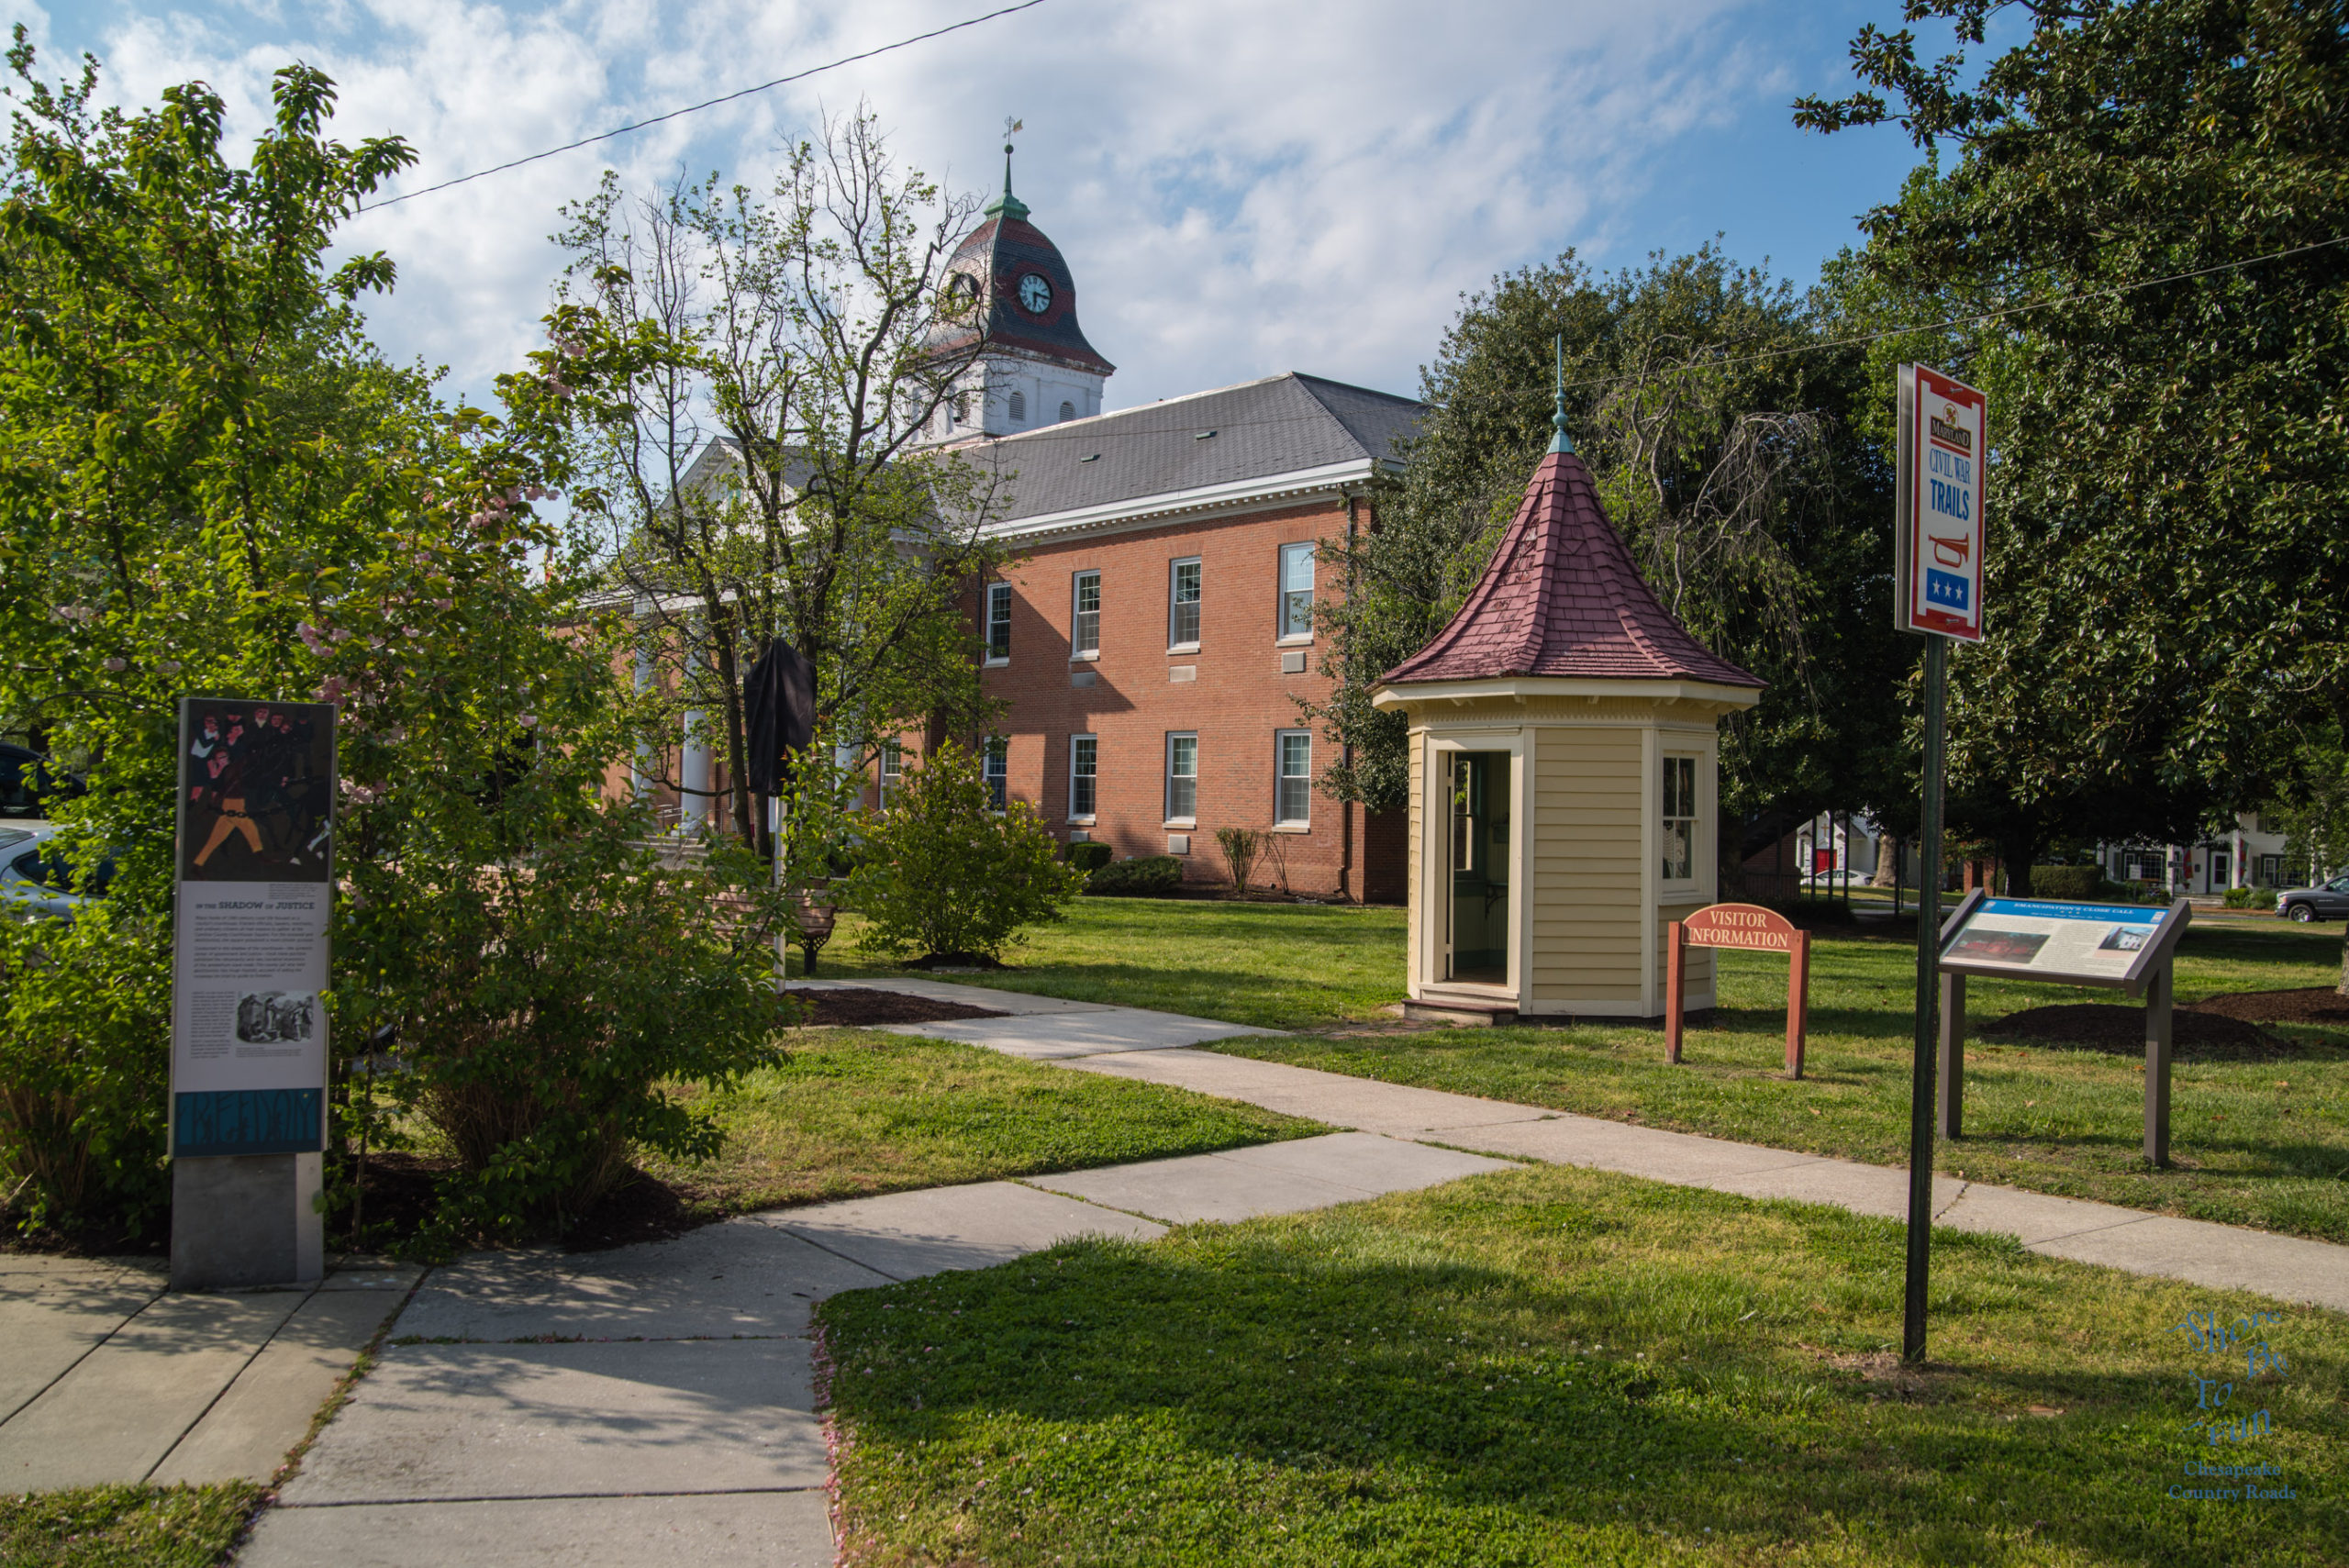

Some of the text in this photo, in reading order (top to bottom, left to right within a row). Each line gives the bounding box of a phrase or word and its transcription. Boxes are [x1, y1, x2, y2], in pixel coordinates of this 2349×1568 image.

[1932, 419, 1969, 447] MARYLAND
[1930, 448, 1971, 484] CIVIL WAR
[1930, 478, 1969, 521] TRAILS
[218, 901, 263, 909] SHADOW
[275, 902, 316, 910] JUSTICE
[1709, 910, 1767, 928] VISITOR
[1688, 927, 1788, 948] INFORMATION
